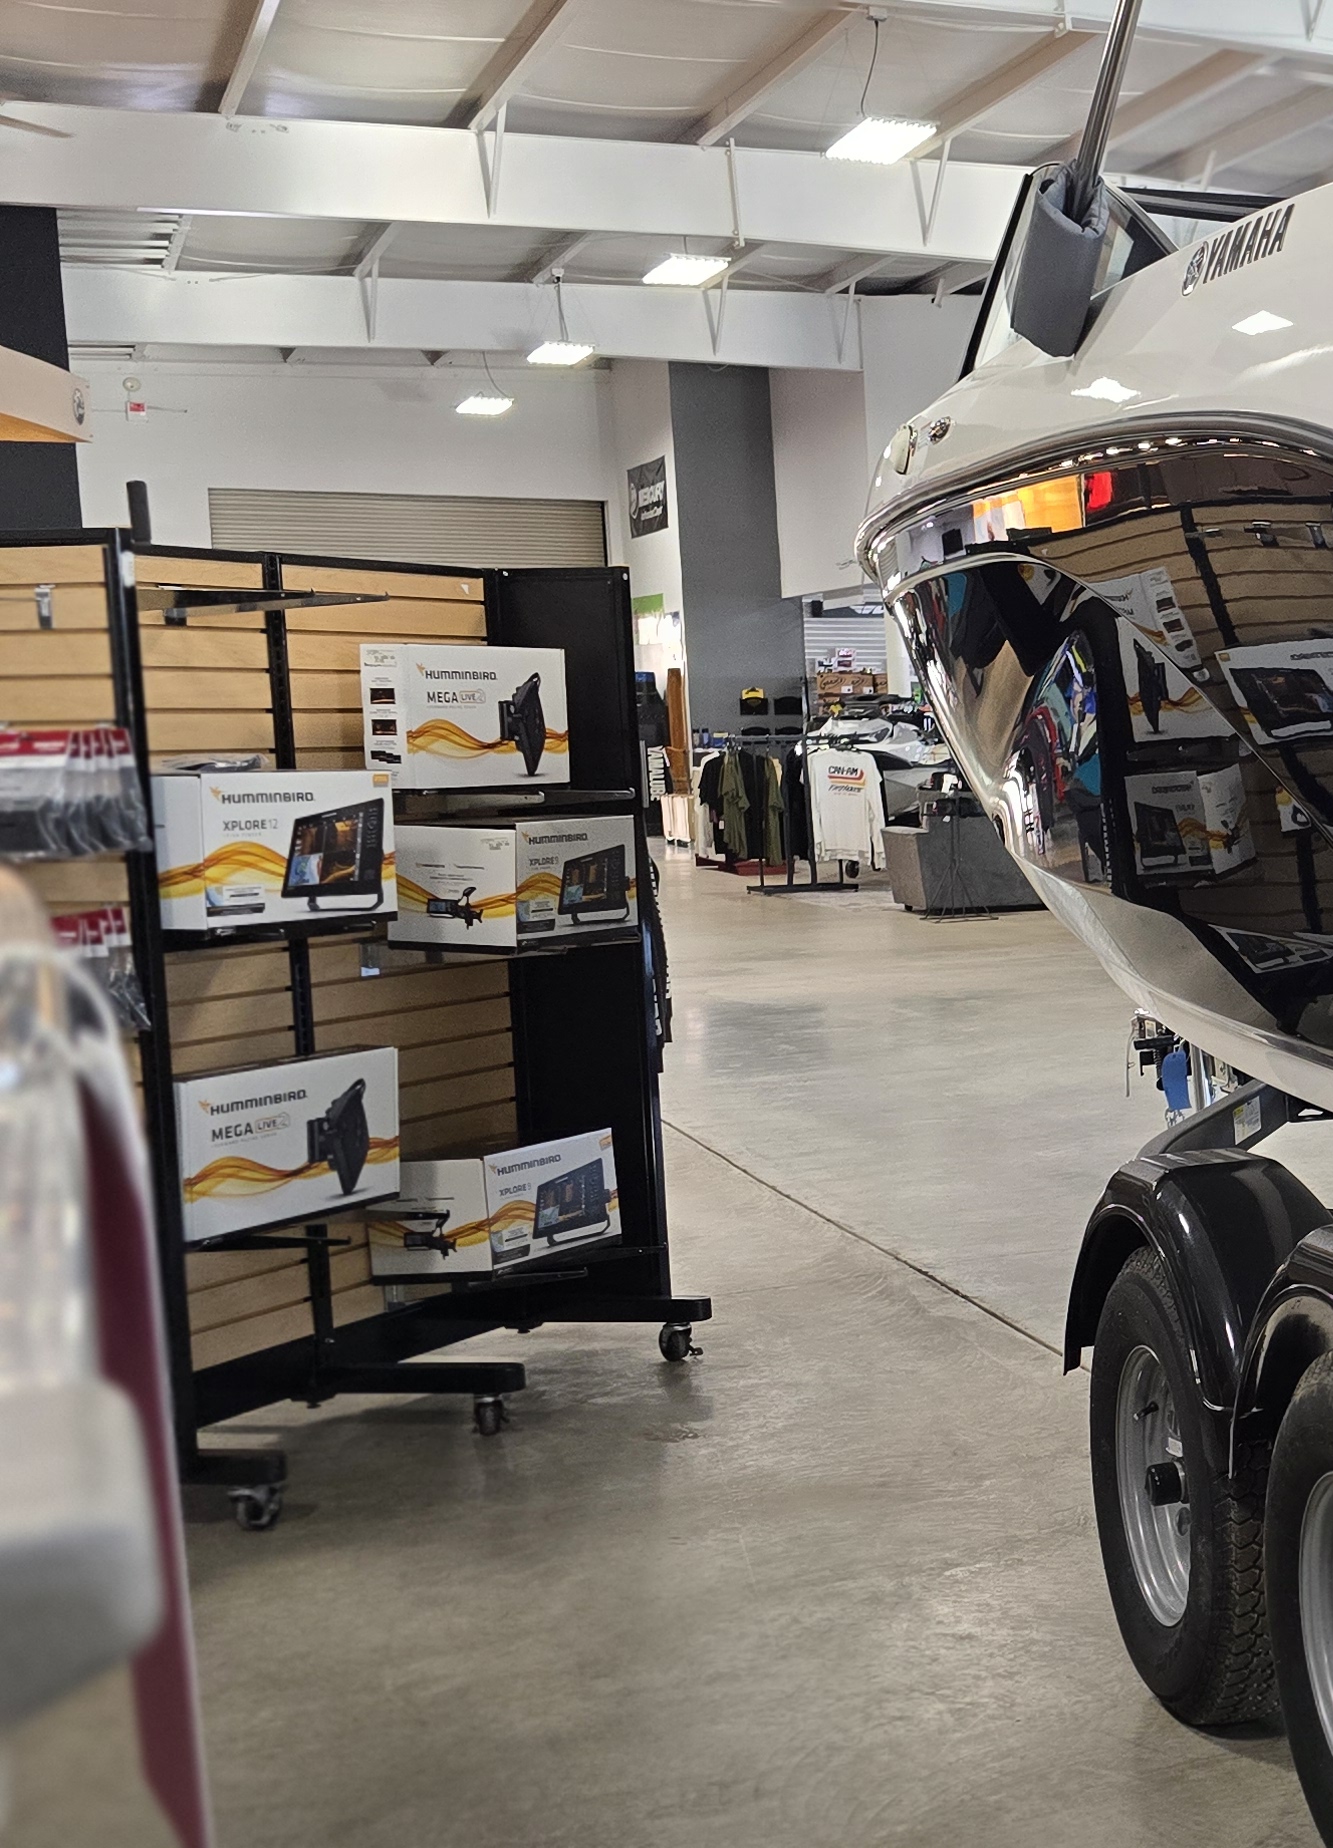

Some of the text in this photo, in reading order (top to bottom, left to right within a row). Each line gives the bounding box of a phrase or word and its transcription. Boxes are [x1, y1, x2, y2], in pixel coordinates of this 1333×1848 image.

[1203, 203, 1295, 285] YAMAHA
[425, 669, 498, 681] HUMMINBIRD
[426, 690, 459, 704] MEGA
[221, 791, 315, 805] HUMMINBIRD
[528, 832, 588, 846] HUMMINBIRD
[210, 1088, 308, 1117] HUMMINBIRD
[211, 1122, 254, 1143] MEGA
[497, 1153, 562, 1177] HUMMINBIRD
